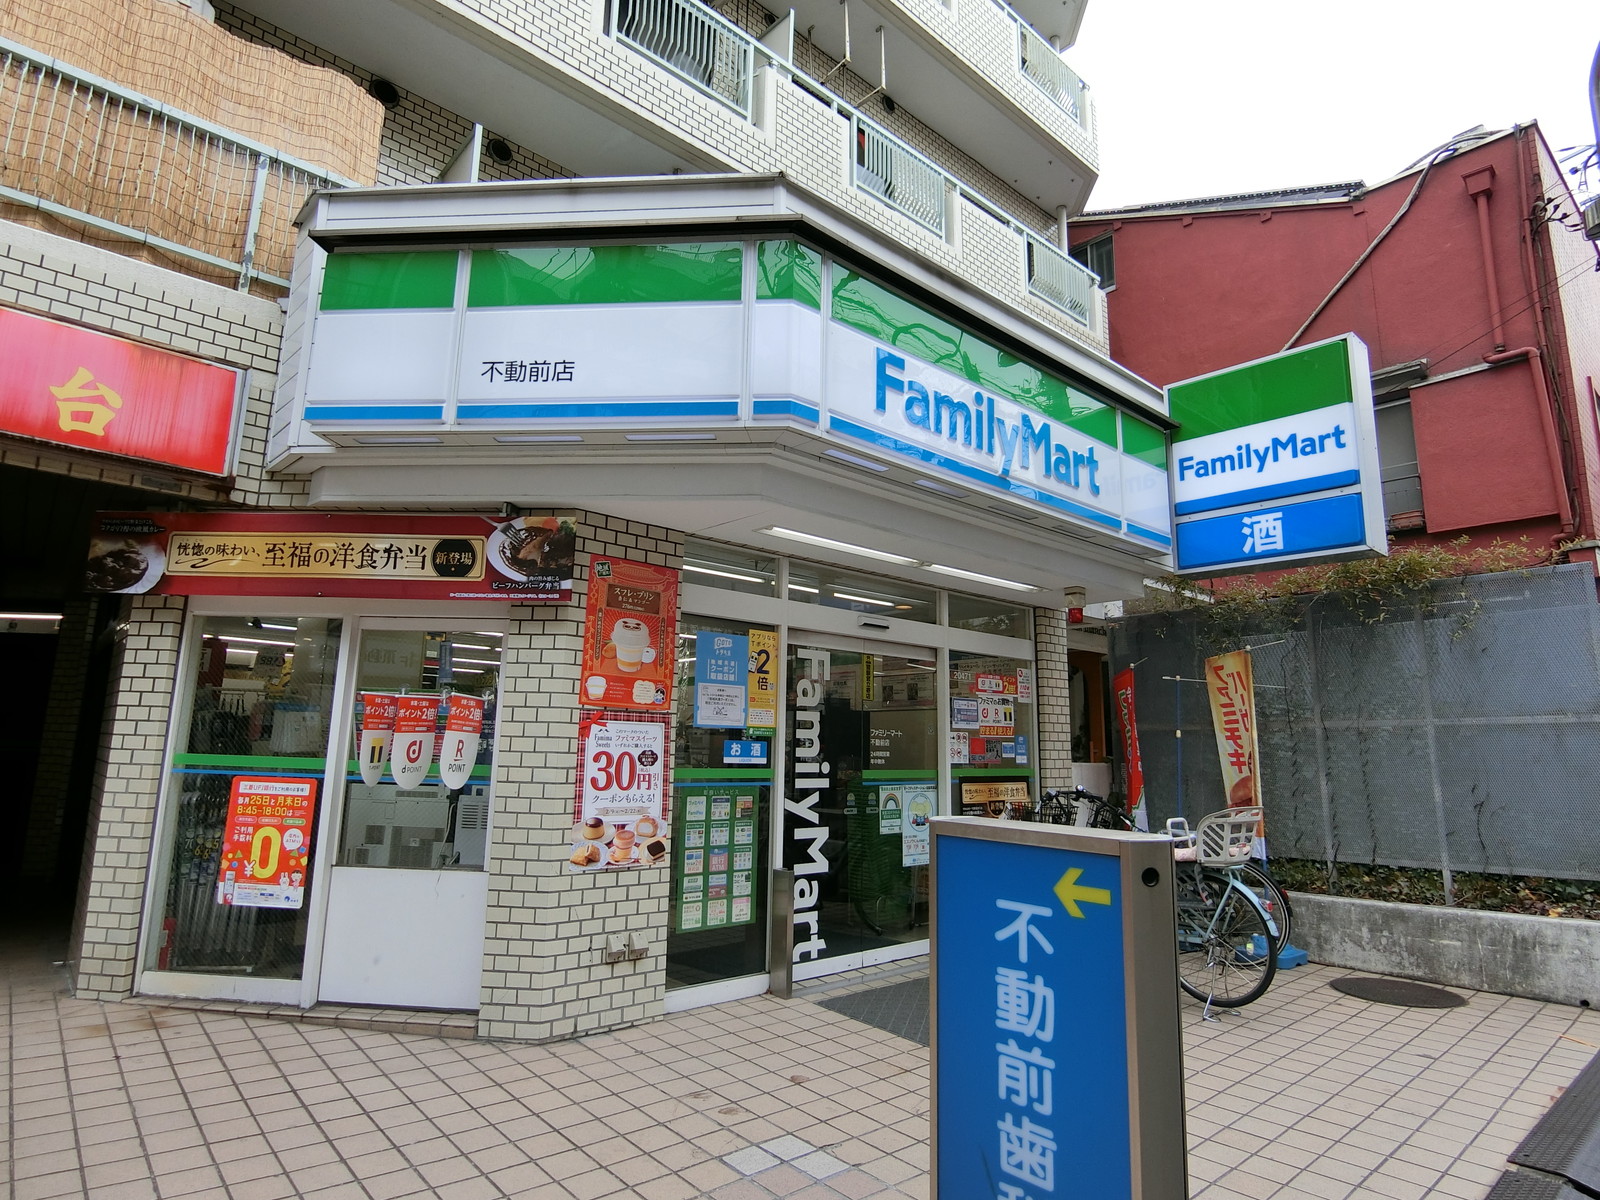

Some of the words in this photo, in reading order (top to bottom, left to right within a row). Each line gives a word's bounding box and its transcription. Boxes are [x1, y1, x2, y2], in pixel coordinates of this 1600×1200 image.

[481, 359, 575, 383] 不動前店
[49, 366, 123, 437] 台
[873, 345, 1101, 497] FamilyMart
[1178, 424, 1347, 482] FamilyMart
[1241, 511, 1284, 555] 酒
[176, 541, 261, 557] 恍惚の味わい、
[262, 541, 427, 570] 至福の洋食弁当
[435, 551, 473, 566] 新登場
[492, 581, 560, 590] ビーフハンバーグ弁当
[614, 586, 655, 601] スフレ・プリン
[750, 633, 776, 642] アプリなら
[756, 648, 771, 675] 2
[709, 672, 735, 682] 取扱店舗
[710, 665, 735, 674] クーポン
[757, 676, 769, 691] 倍
[398, 707, 439, 720] ポイント2倍!
[449, 706, 483, 721] ポイント2倍!
[594, 733, 613, 741] Famima
[615, 735, 658, 743] ファミマスイーツ
[870, 729, 903, 738] ファミリーマート
[455, 739, 465, 758] R
[595, 740, 611, 748] Sweets
[730, 742, 762, 757] お酒
[870, 738, 890, 747] 不動前店
[448, 763, 466, 773] POINT
[590, 751, 638, 792] 30
[637, 773, 652, 790] 円
[652, 772, 660, 791] 引き
[591, 793, 655, 804] クーポンもらえる!
[784, 648, 831, 963] FamilyMart
[234, 826, 254, 834] ご利用
[233, 834, 253, 842] 手数料
